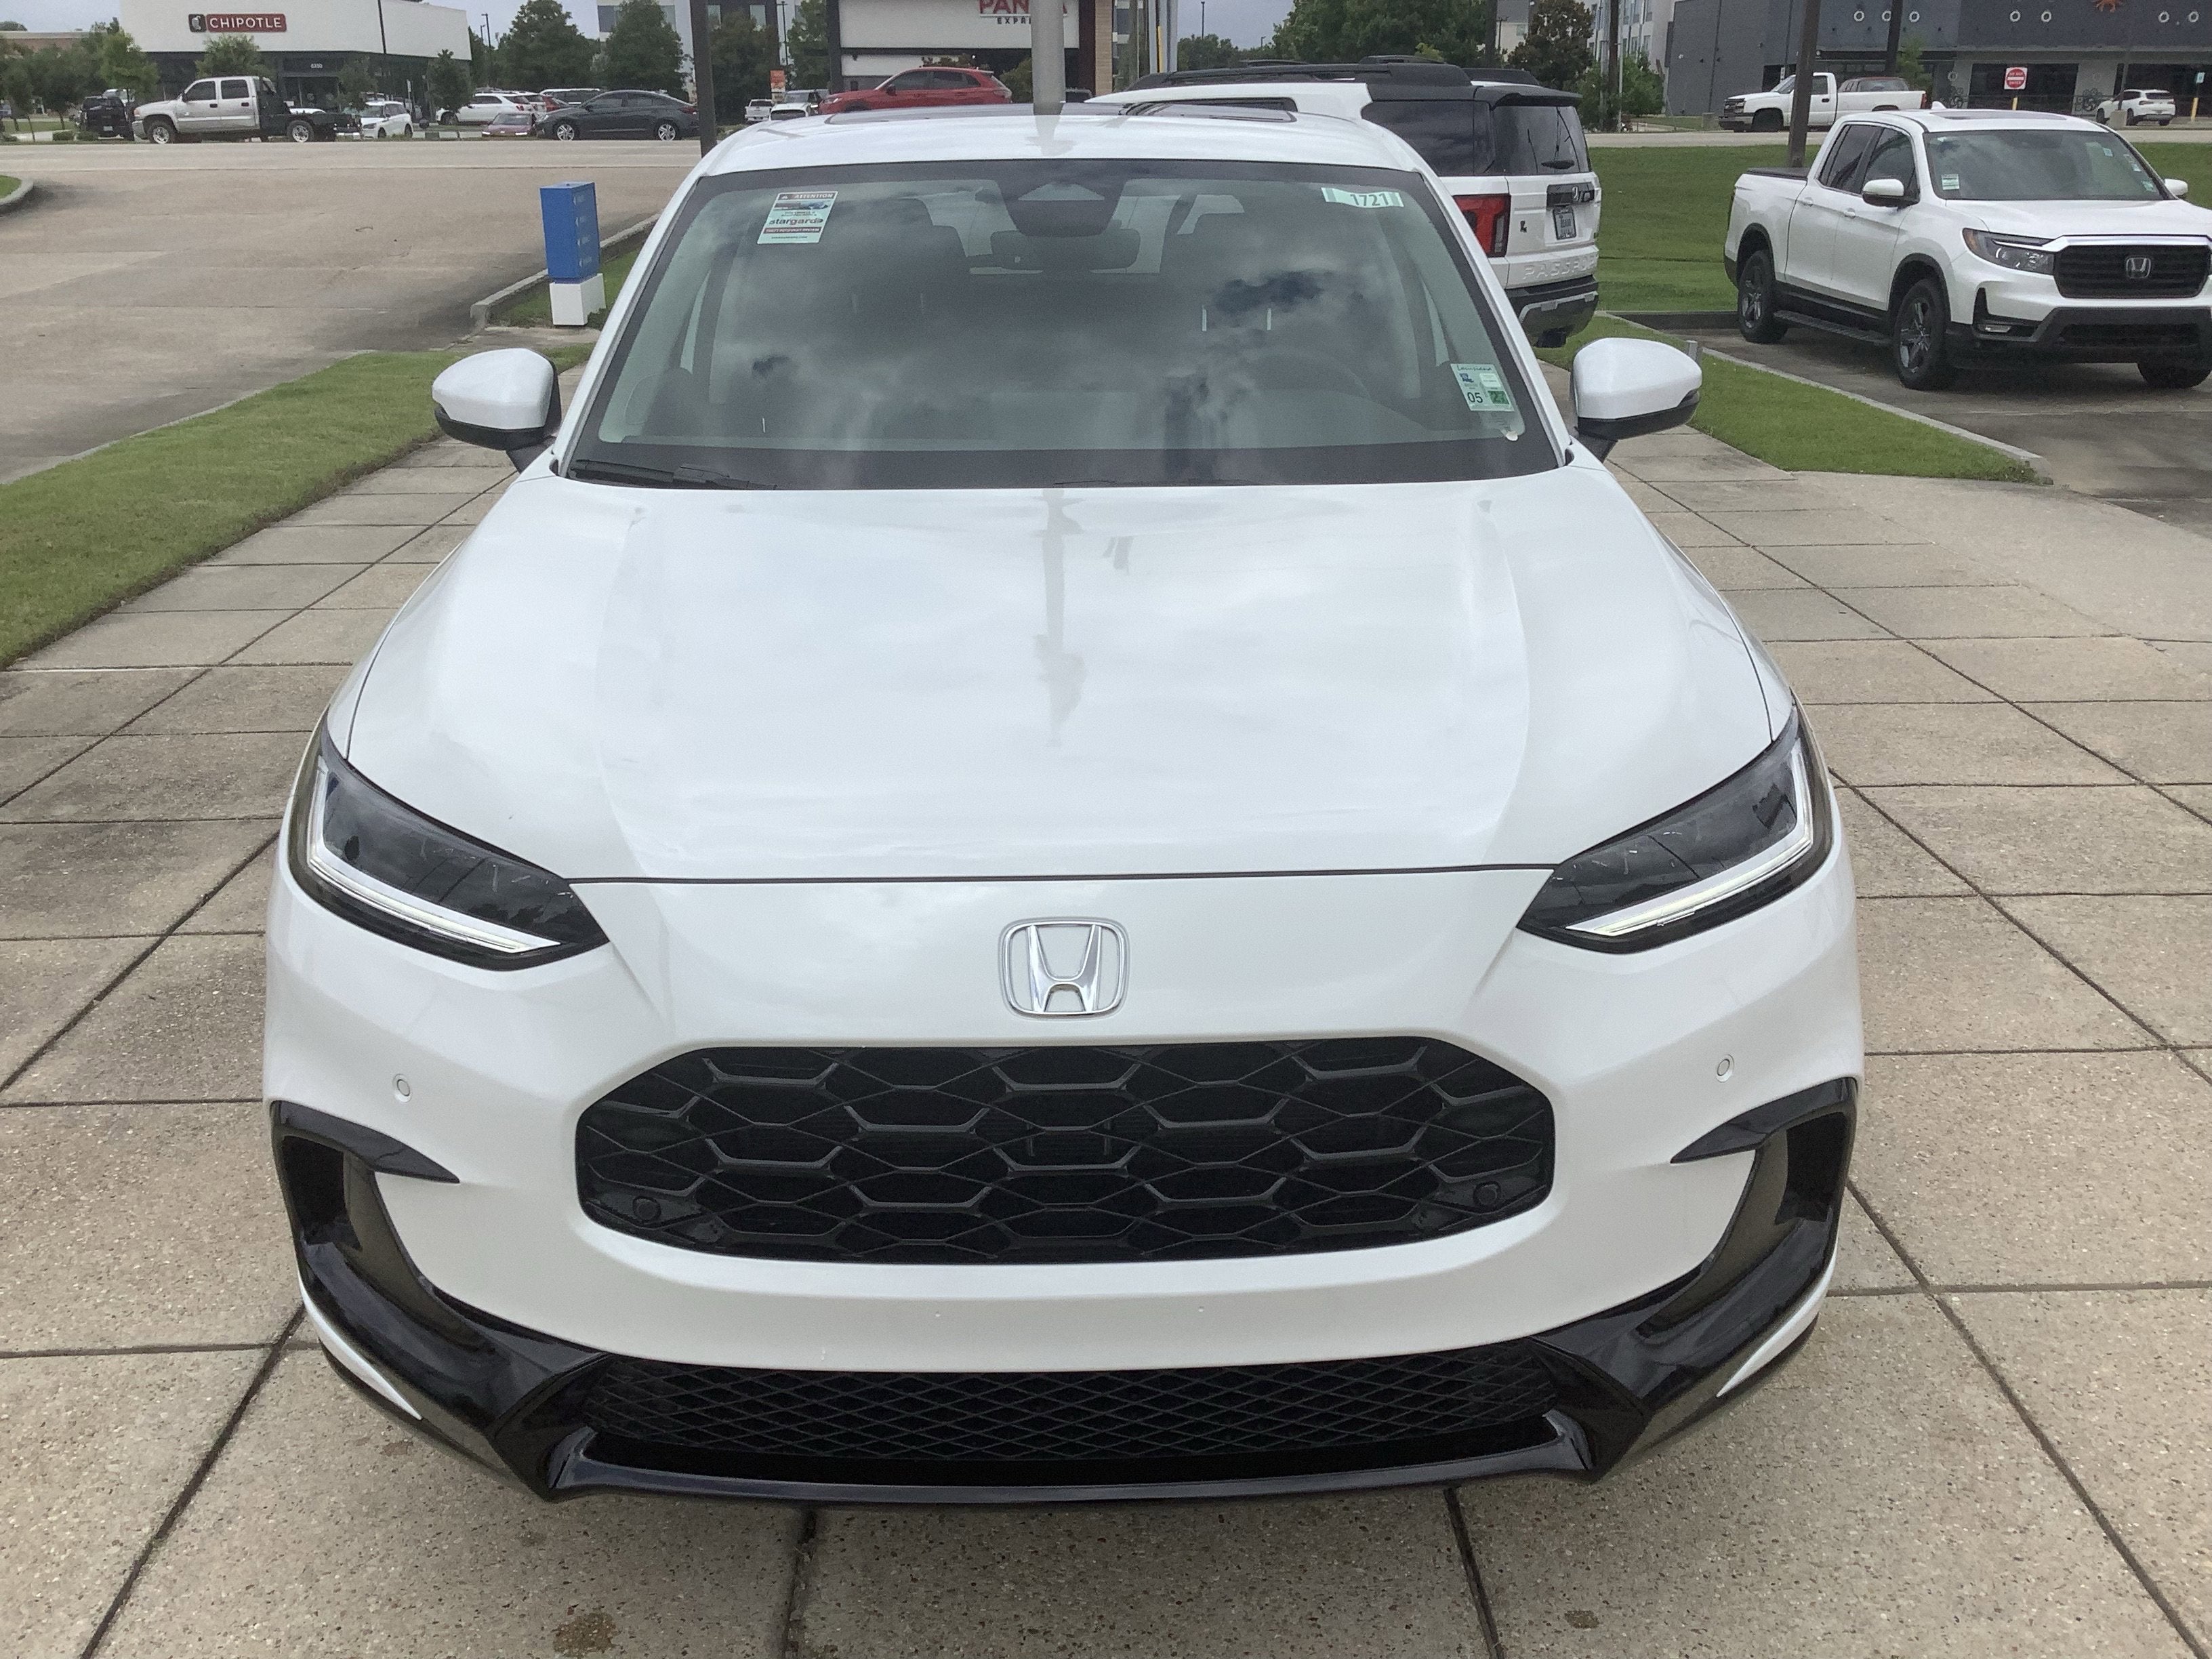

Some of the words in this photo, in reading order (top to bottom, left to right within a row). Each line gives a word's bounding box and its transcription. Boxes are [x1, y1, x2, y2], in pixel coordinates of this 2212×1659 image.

[209, 18, 282, 28] CHIPOTLE
[1349, 192, 1389, 207] 1721
[1467, 392, 1483, 403] 05
